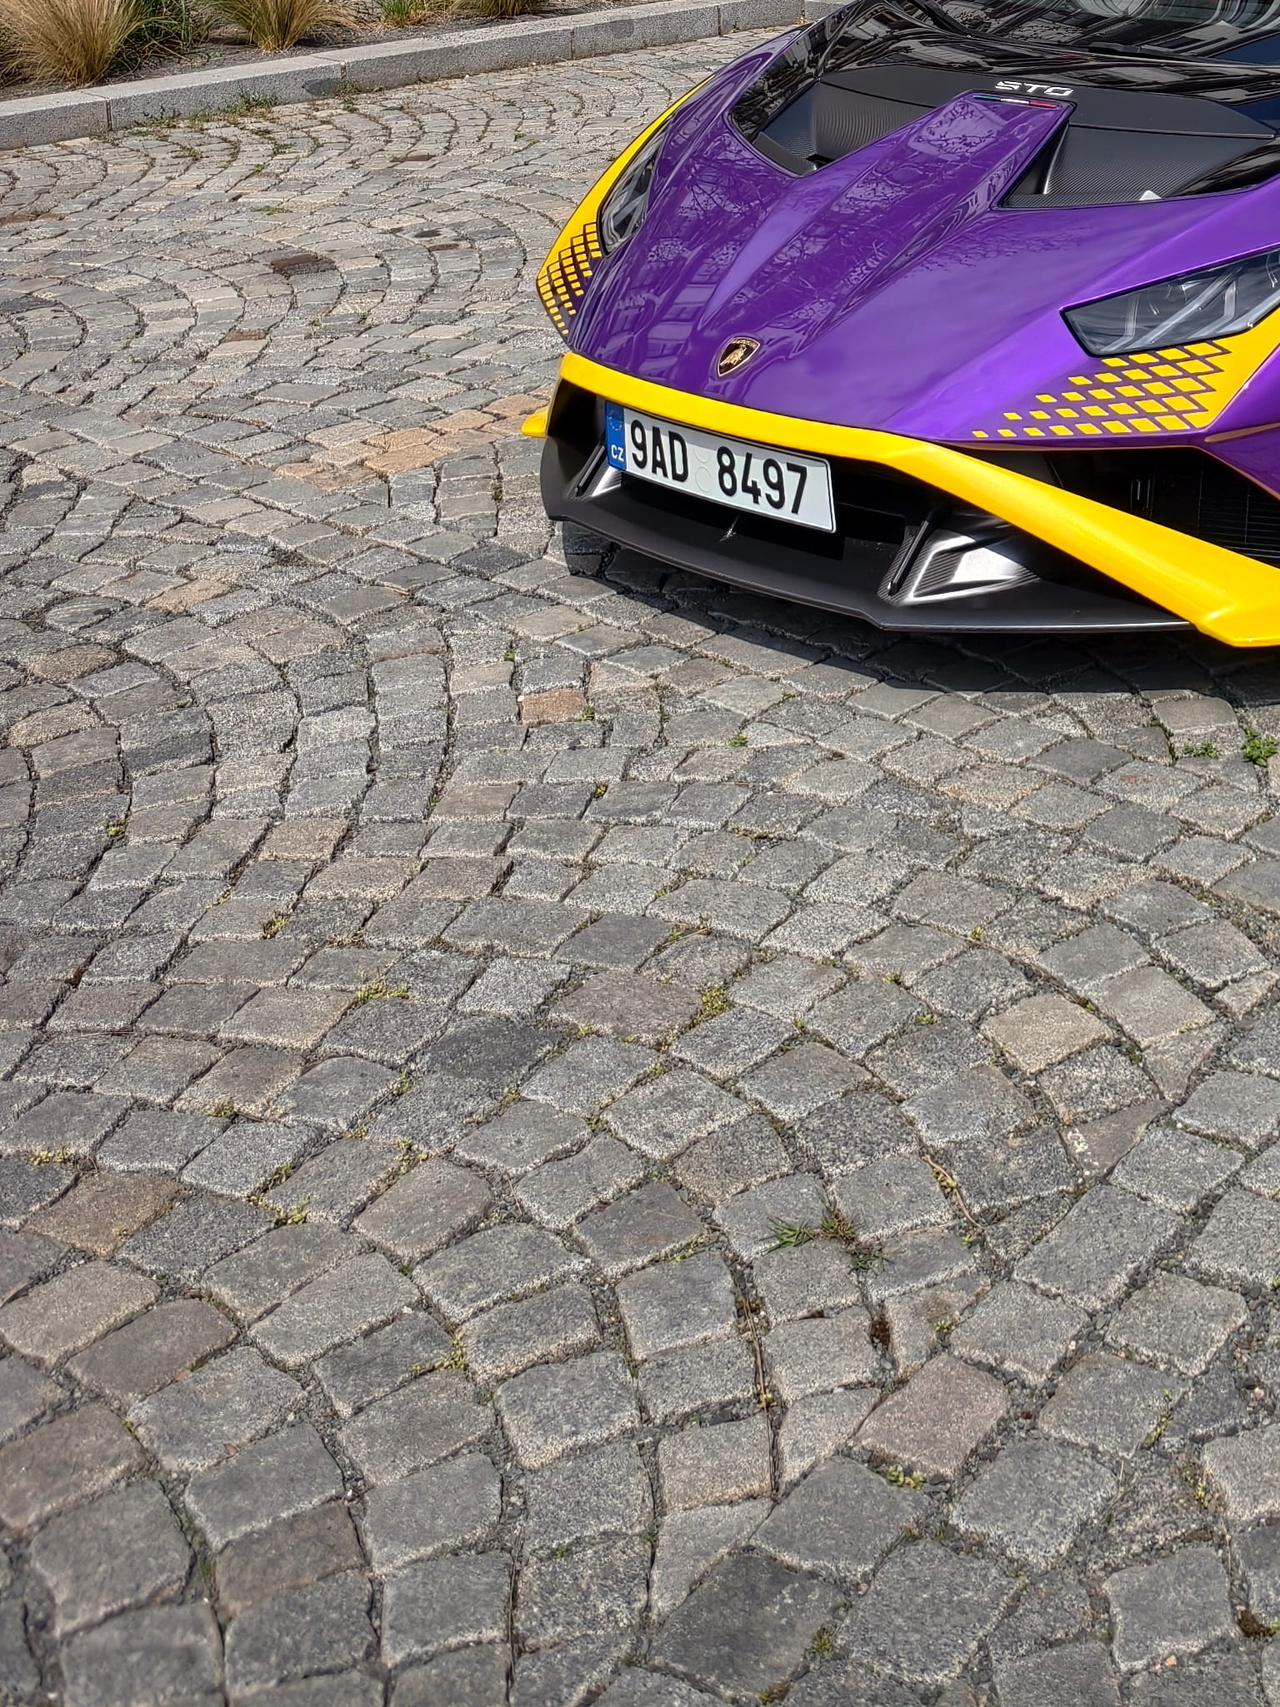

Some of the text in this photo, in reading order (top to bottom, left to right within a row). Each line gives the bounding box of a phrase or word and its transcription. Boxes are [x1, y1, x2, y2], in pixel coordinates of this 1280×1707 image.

[994, 80, 1075, 97] STO
[611, 418, 808, 515] CZ 9AD 8497
